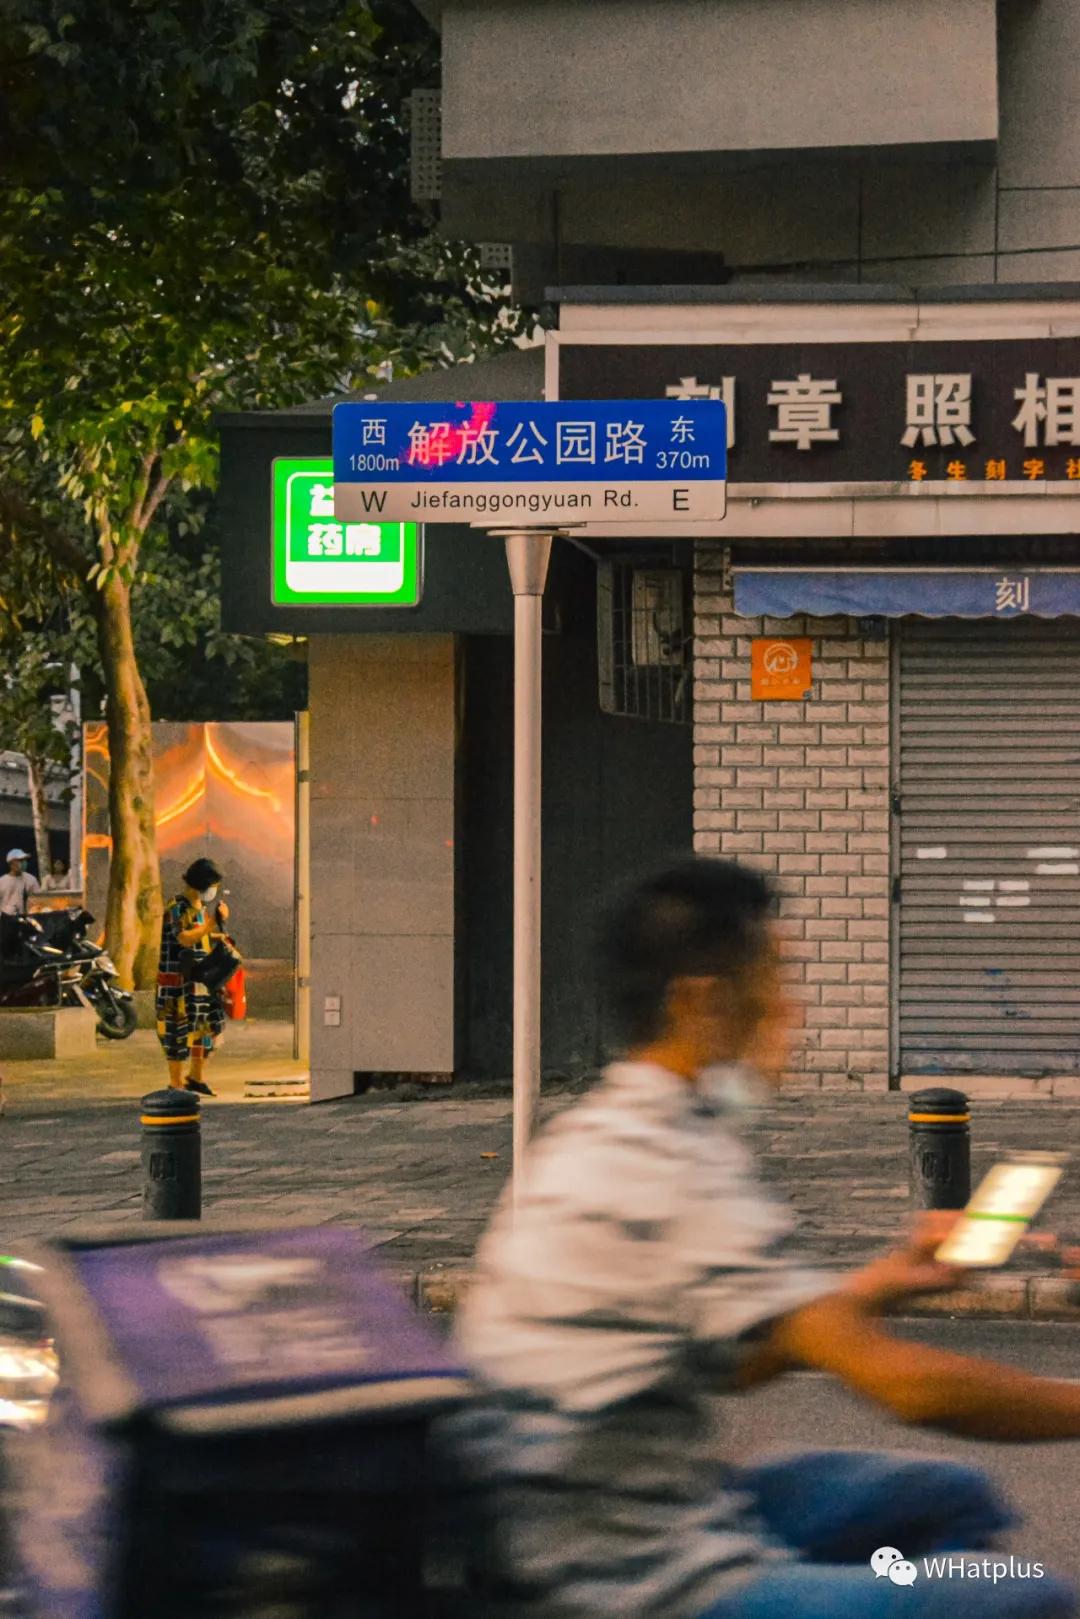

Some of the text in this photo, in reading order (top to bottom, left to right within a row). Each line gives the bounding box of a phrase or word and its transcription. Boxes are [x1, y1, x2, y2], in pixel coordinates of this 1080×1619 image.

[361, 418, 388, 447] 西
[669, 415, 695, 444] 东
[406, 419, 648, 467] 解放公园路
[349, 454, 400, 472] 1800m
[656, 451, 710, 470] 370m
[361, 490, 388, 513] W
[410, 490, 639, 513] Jiefanggongyuan Rd.
[672, 489, 690, 511] E
[995, 575, 1029, 611] 刻
